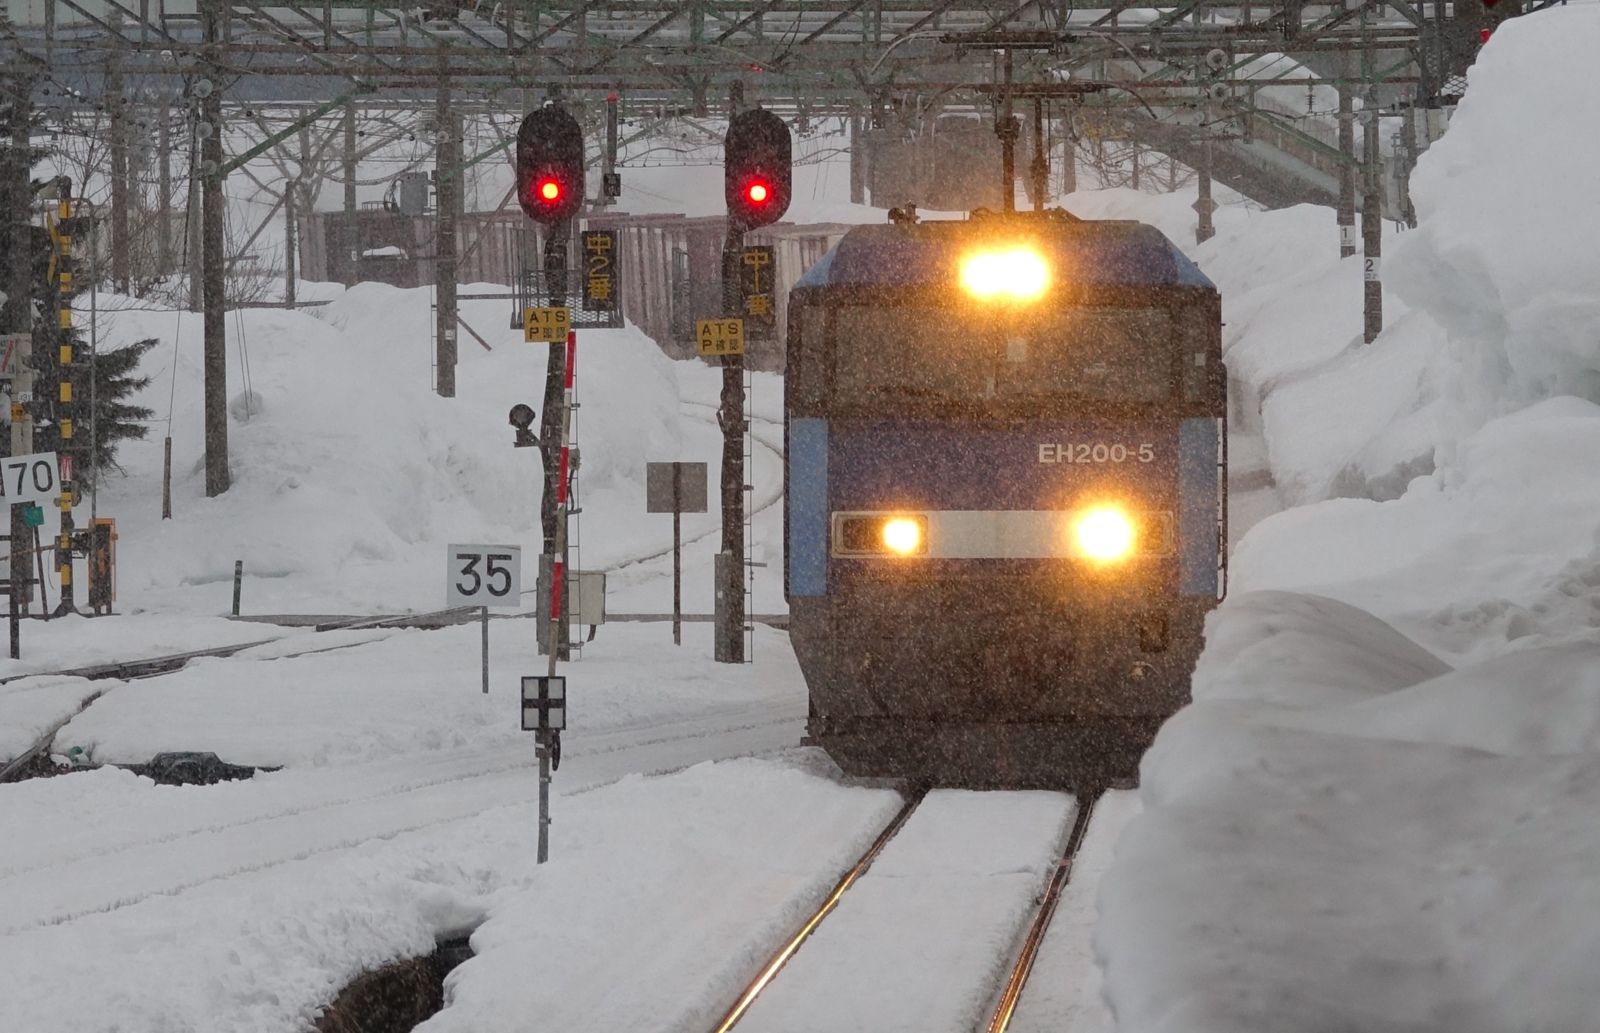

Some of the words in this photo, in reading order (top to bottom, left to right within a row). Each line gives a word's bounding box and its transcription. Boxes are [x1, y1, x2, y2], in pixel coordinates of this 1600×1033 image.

[1365, 258, 1374, 272] 2
[529, 310, 566, 323] ATS
[702, 322, 739, 336] ATS
[1038, 443, 1154, 464] EH200-5
[8, 460, 53, 496] 70
[455, 553, 512, 597] 35
